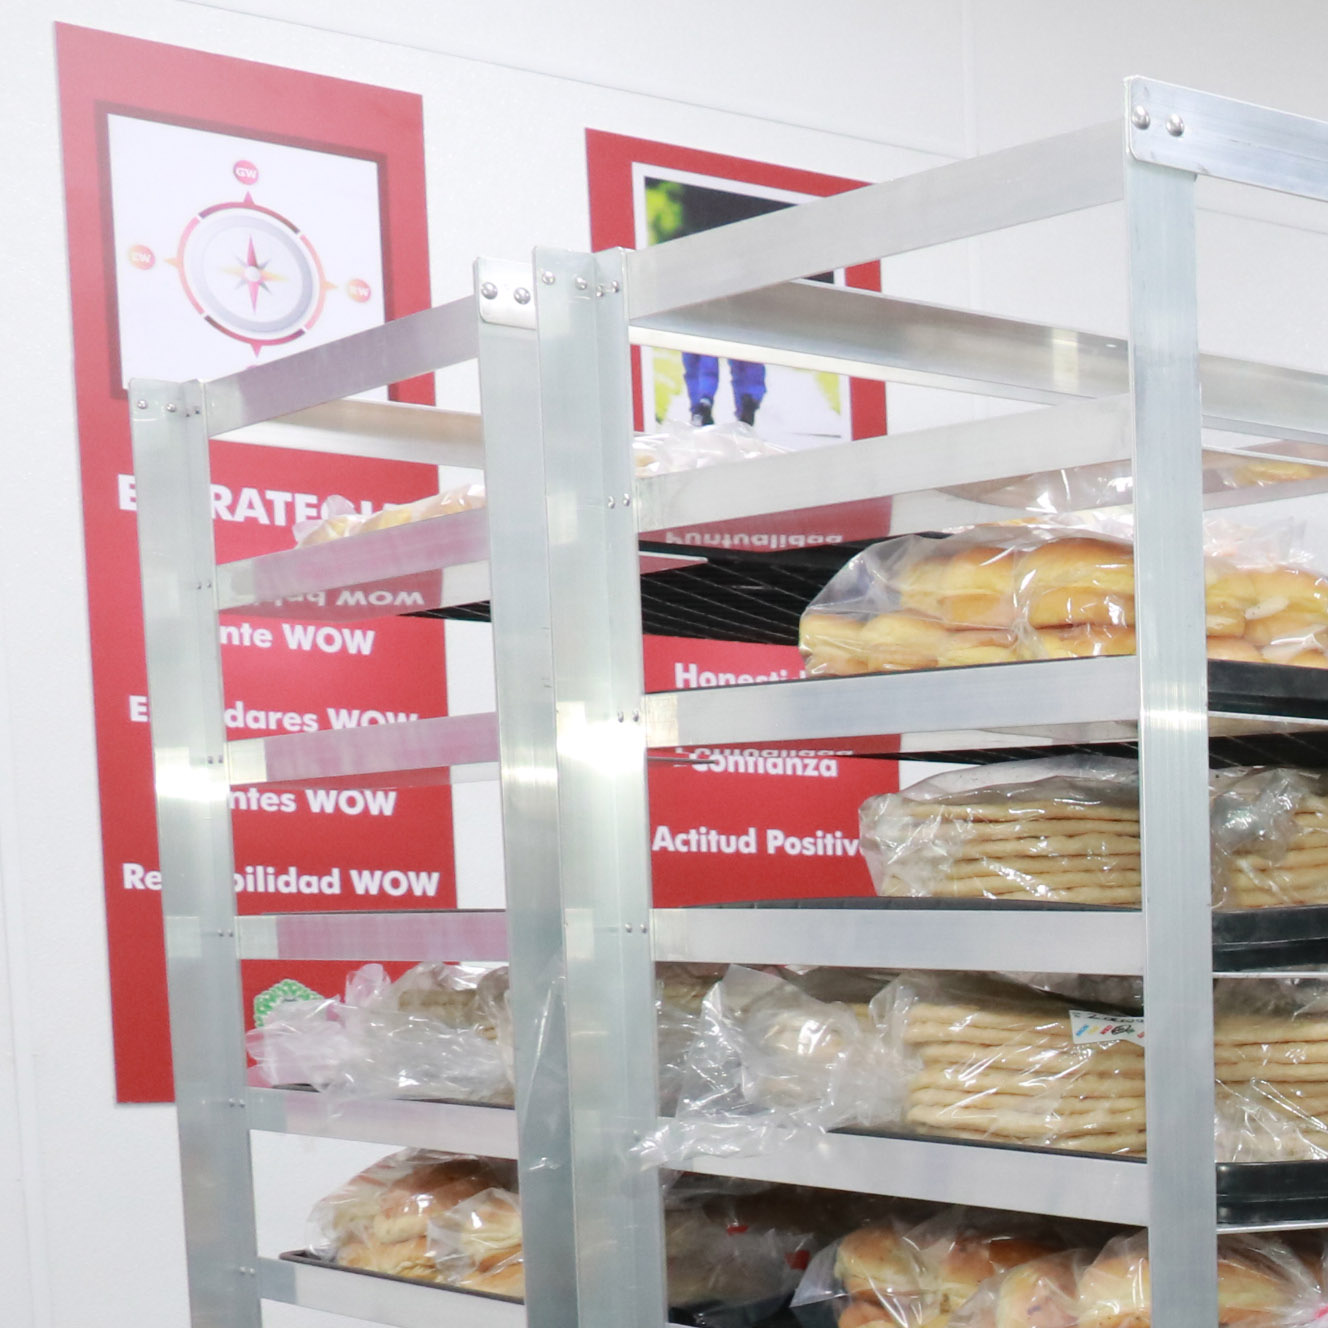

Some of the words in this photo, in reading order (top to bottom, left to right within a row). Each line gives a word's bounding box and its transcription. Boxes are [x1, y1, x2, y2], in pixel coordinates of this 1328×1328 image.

[282, 623, 375, 656] WOW
[305, 790, 397, 817] WOW
[651, 824, 758, 855] Actitud
[764, 828, 862, 858] Positiv
[350, 870, 441, 897] WOW
